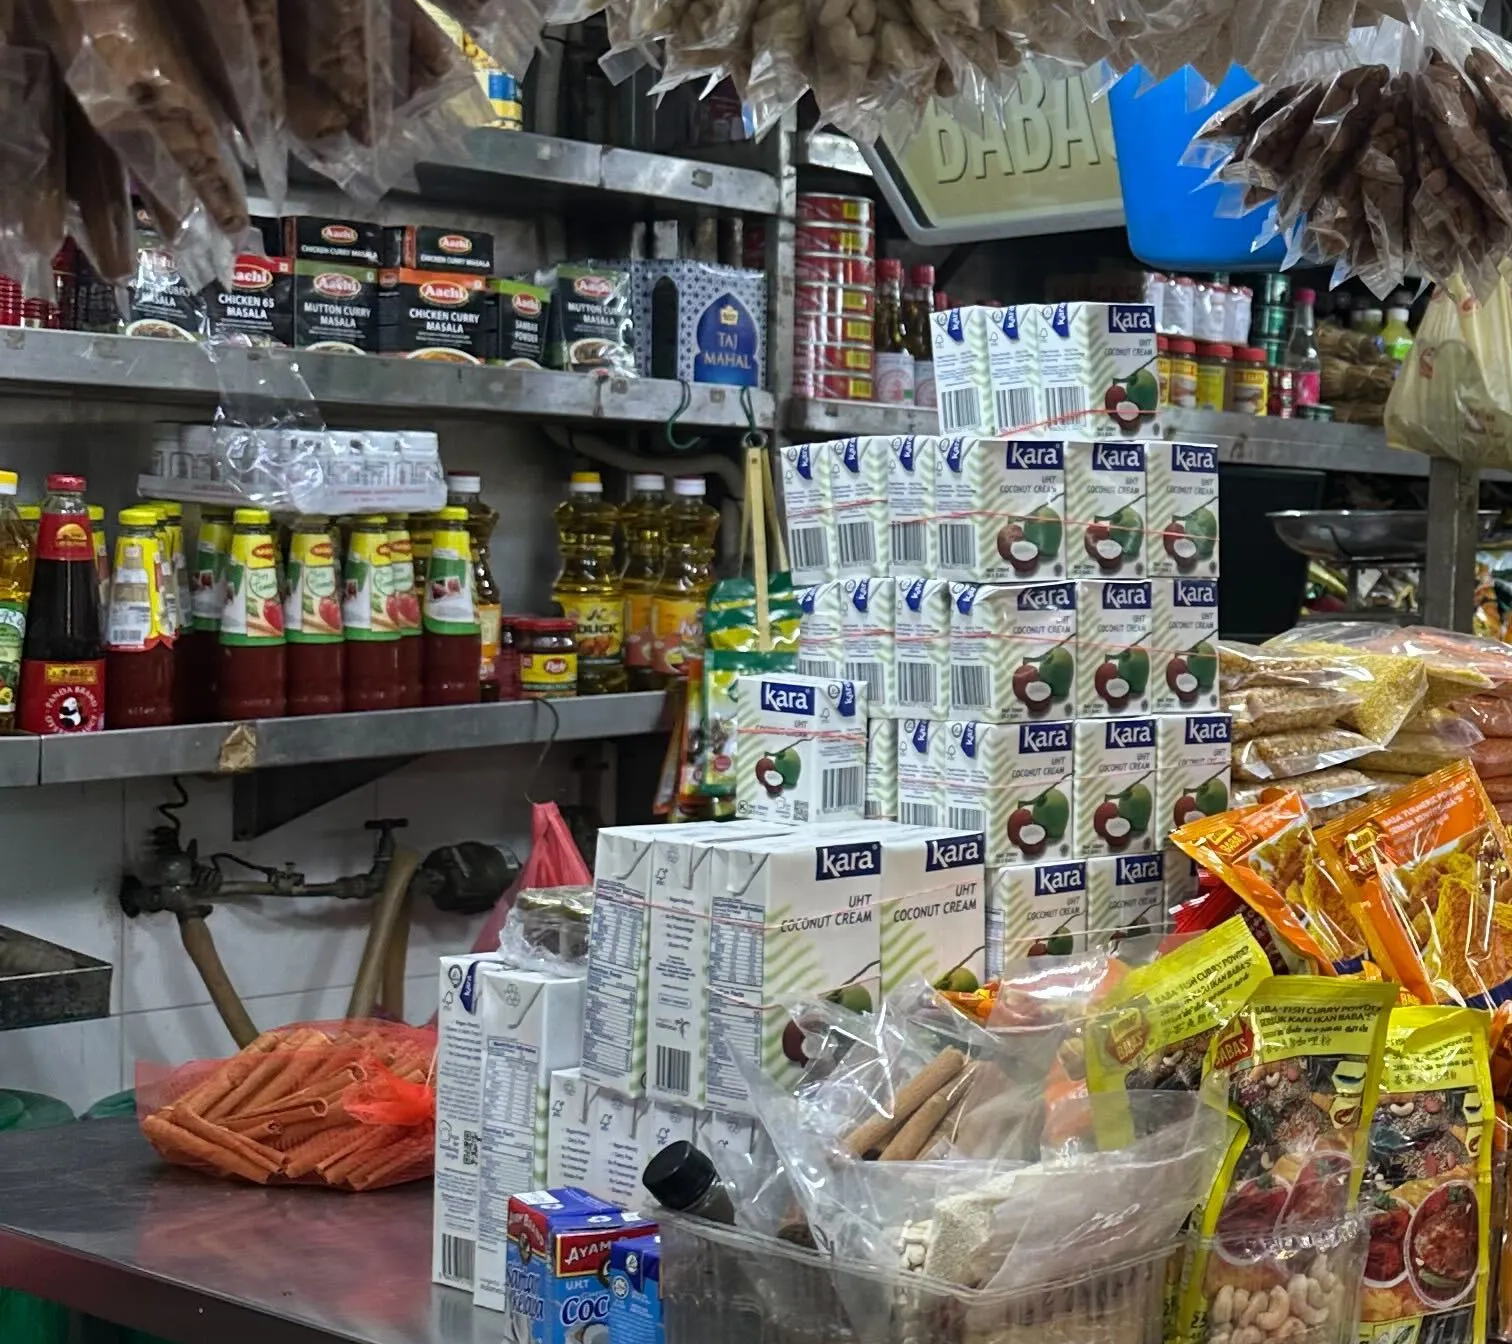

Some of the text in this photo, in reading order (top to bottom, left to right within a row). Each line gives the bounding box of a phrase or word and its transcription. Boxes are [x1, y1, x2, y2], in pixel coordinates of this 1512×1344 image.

[218, 292, 275, 308] CHICKEN 65
[422, 283, 466, 302] Aachi
[226, 306, 268, 320] MASALA
[304, 302, 372, 319] MUTTON CURRY
[319, 315, 357, 329] MASALA
[408, 307, 480, 324] CHICKEN CURRY
[1112, 308, 1151, 333] kara
[425, 320, 465, 334] MASALA
[715, 332, 738, 351] TAJ
[703, 351, 751, 370] MAHAL
[1011, 443, 1058, 469] kara
[1098, 445, 1140, 468] kara
[1175, 447, 1214, 471] kara
[1022, 588, 1070, 610] kara
[1105, 587, 1147, 608] kara
[1177, 580, 1215, 606] kara
[765, 684, 808, 711] kara
[1023, 725, 1068, 752] kara
[1109, 722, 1151, 748] kara
[1189, 717, 1227, 743] kara
[821, 849, 874, 879] kara
[931, 840, 980, 866] kara
[1040, 868, 1082, 894] kara
[1119, 857, 1159, 883] kara
[848, 893, 872, 909] UHT
[955, 882, 978, 898] UHT
[780, 909, 873, 933] COCONUT CREAM
[893, 899, 978, 923] COCONUT CREAM
[564, 1240, 611, 1266] AYAM
